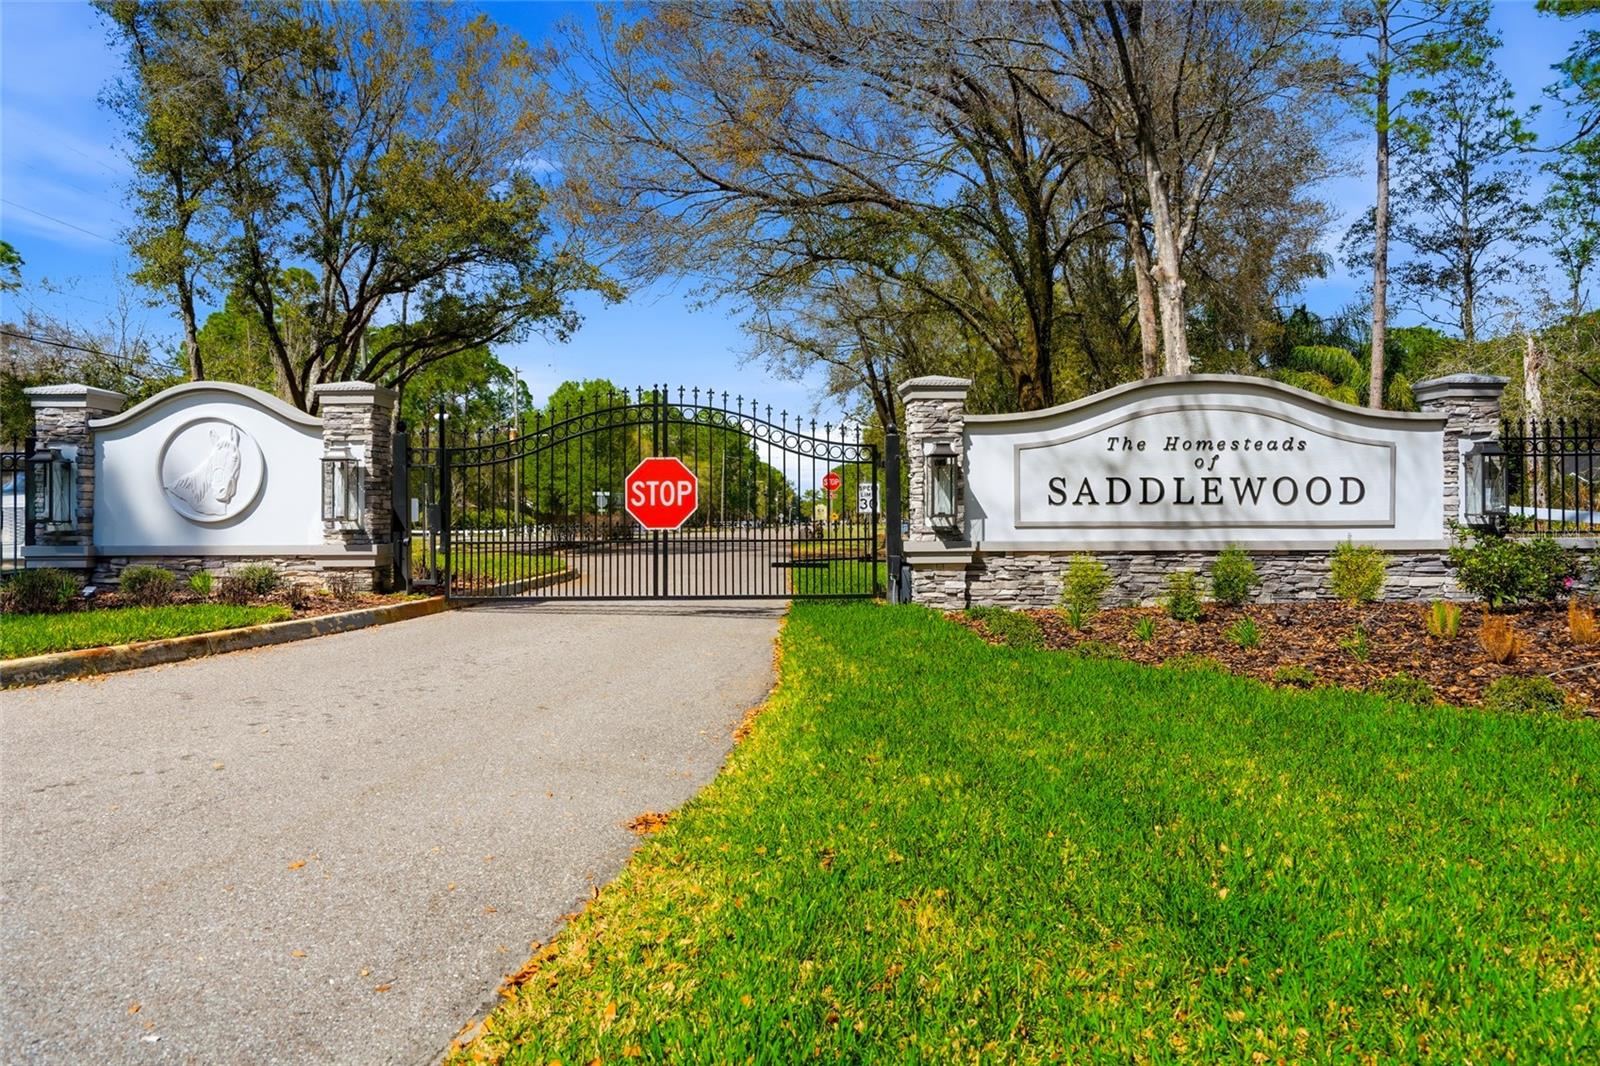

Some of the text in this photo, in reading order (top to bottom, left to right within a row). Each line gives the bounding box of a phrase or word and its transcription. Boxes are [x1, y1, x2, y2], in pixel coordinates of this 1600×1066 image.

[1107, 436, 1308, 451] The Homesteads
[1194, 454, 1220, 471] of
[631, 480, 692, 506] STOP
[1048, 476, 1366, 506] SADDLEWOOD
